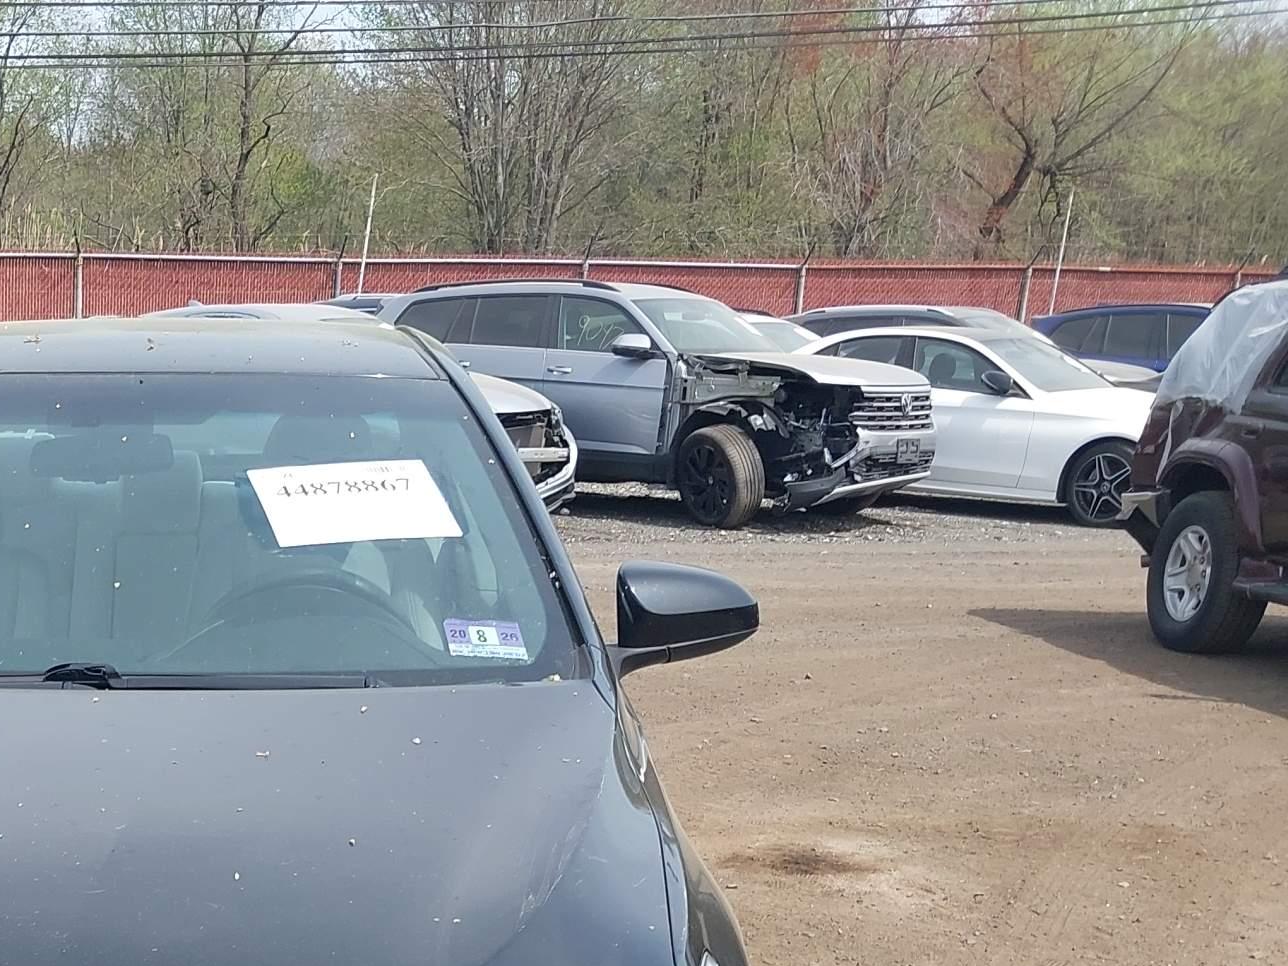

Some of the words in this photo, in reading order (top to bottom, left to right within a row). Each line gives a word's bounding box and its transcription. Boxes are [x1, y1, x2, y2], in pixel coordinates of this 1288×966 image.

[276, 478, 409, 498] 44878867
[449, 628, 467, 639] 20
[476, 629, 488, 643] 8
[499, 631, 520, 641] 26
